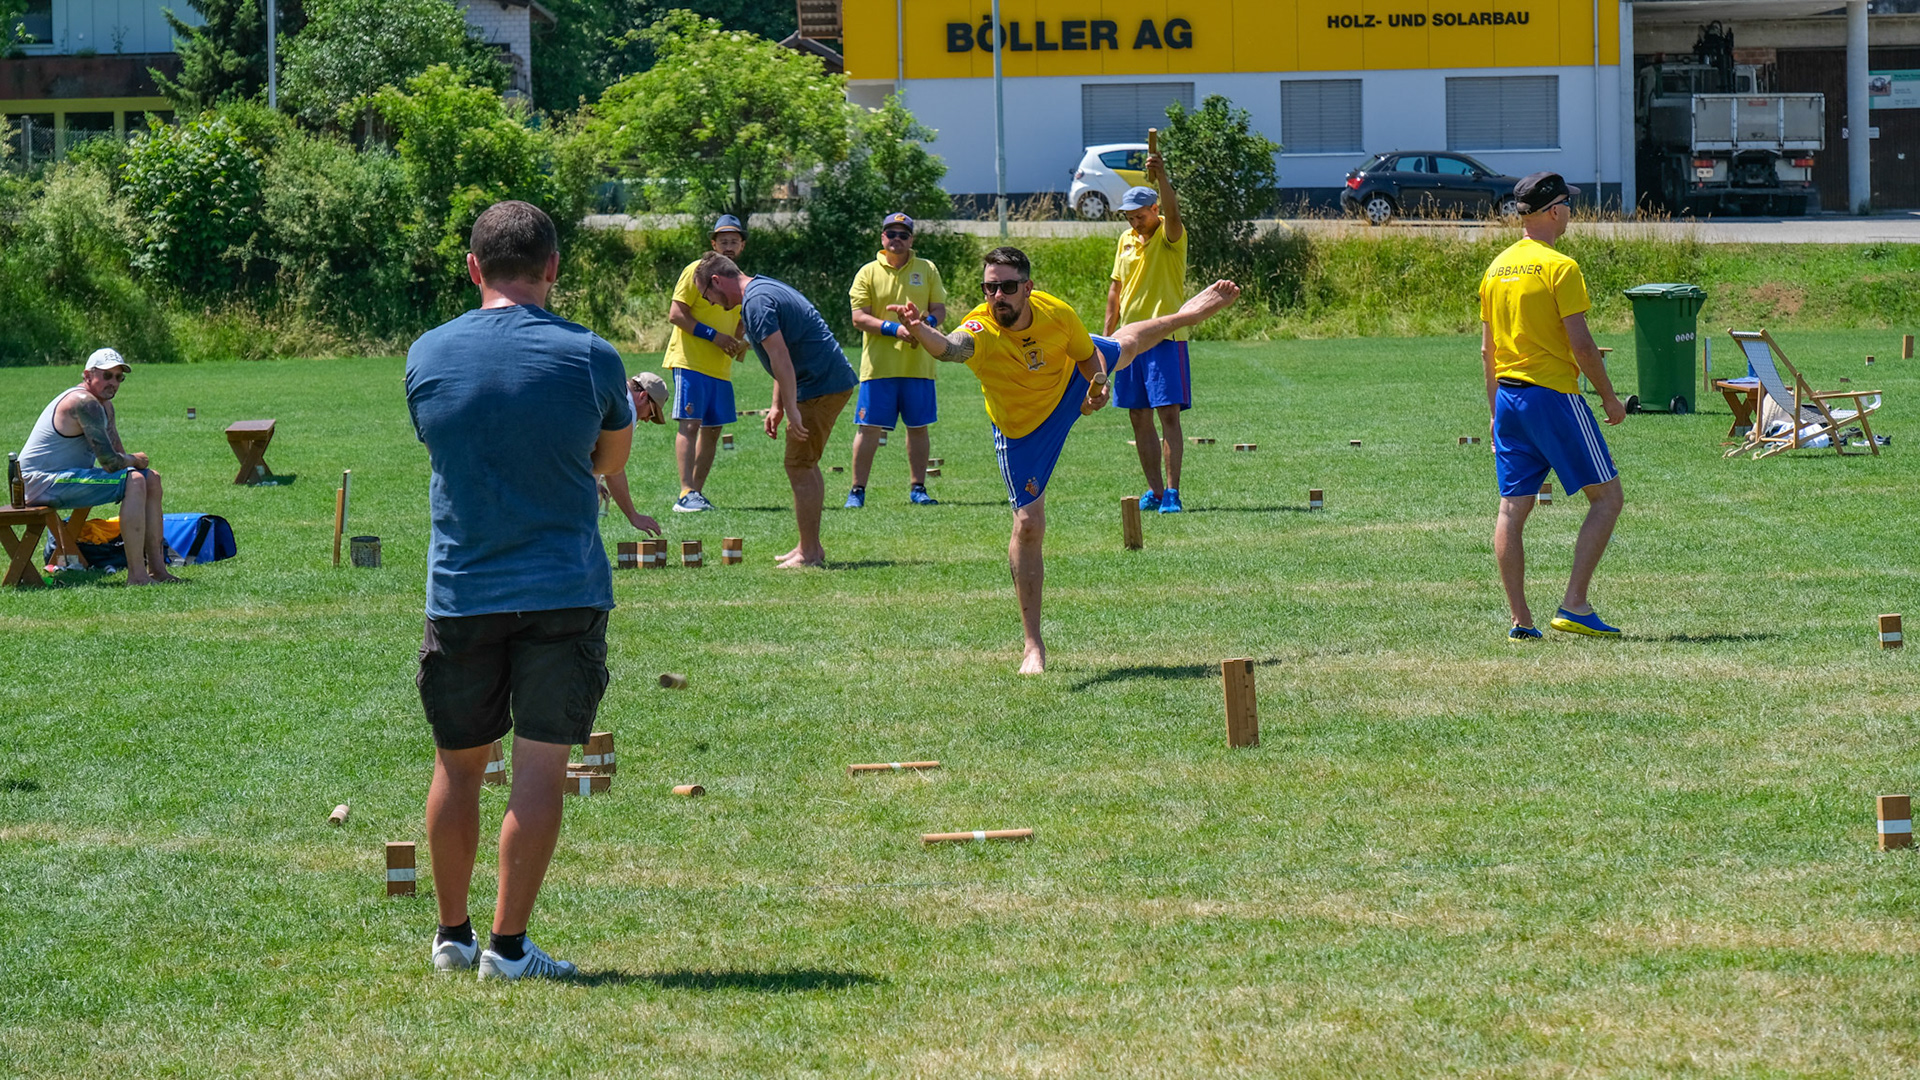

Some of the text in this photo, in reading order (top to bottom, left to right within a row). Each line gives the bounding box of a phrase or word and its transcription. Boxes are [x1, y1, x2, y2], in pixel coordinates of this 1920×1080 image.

[946, 14, 1193, 53] BÖLLER AG
[1327, 11, 1530, 29] HOLZ- UND SOLARBAU
